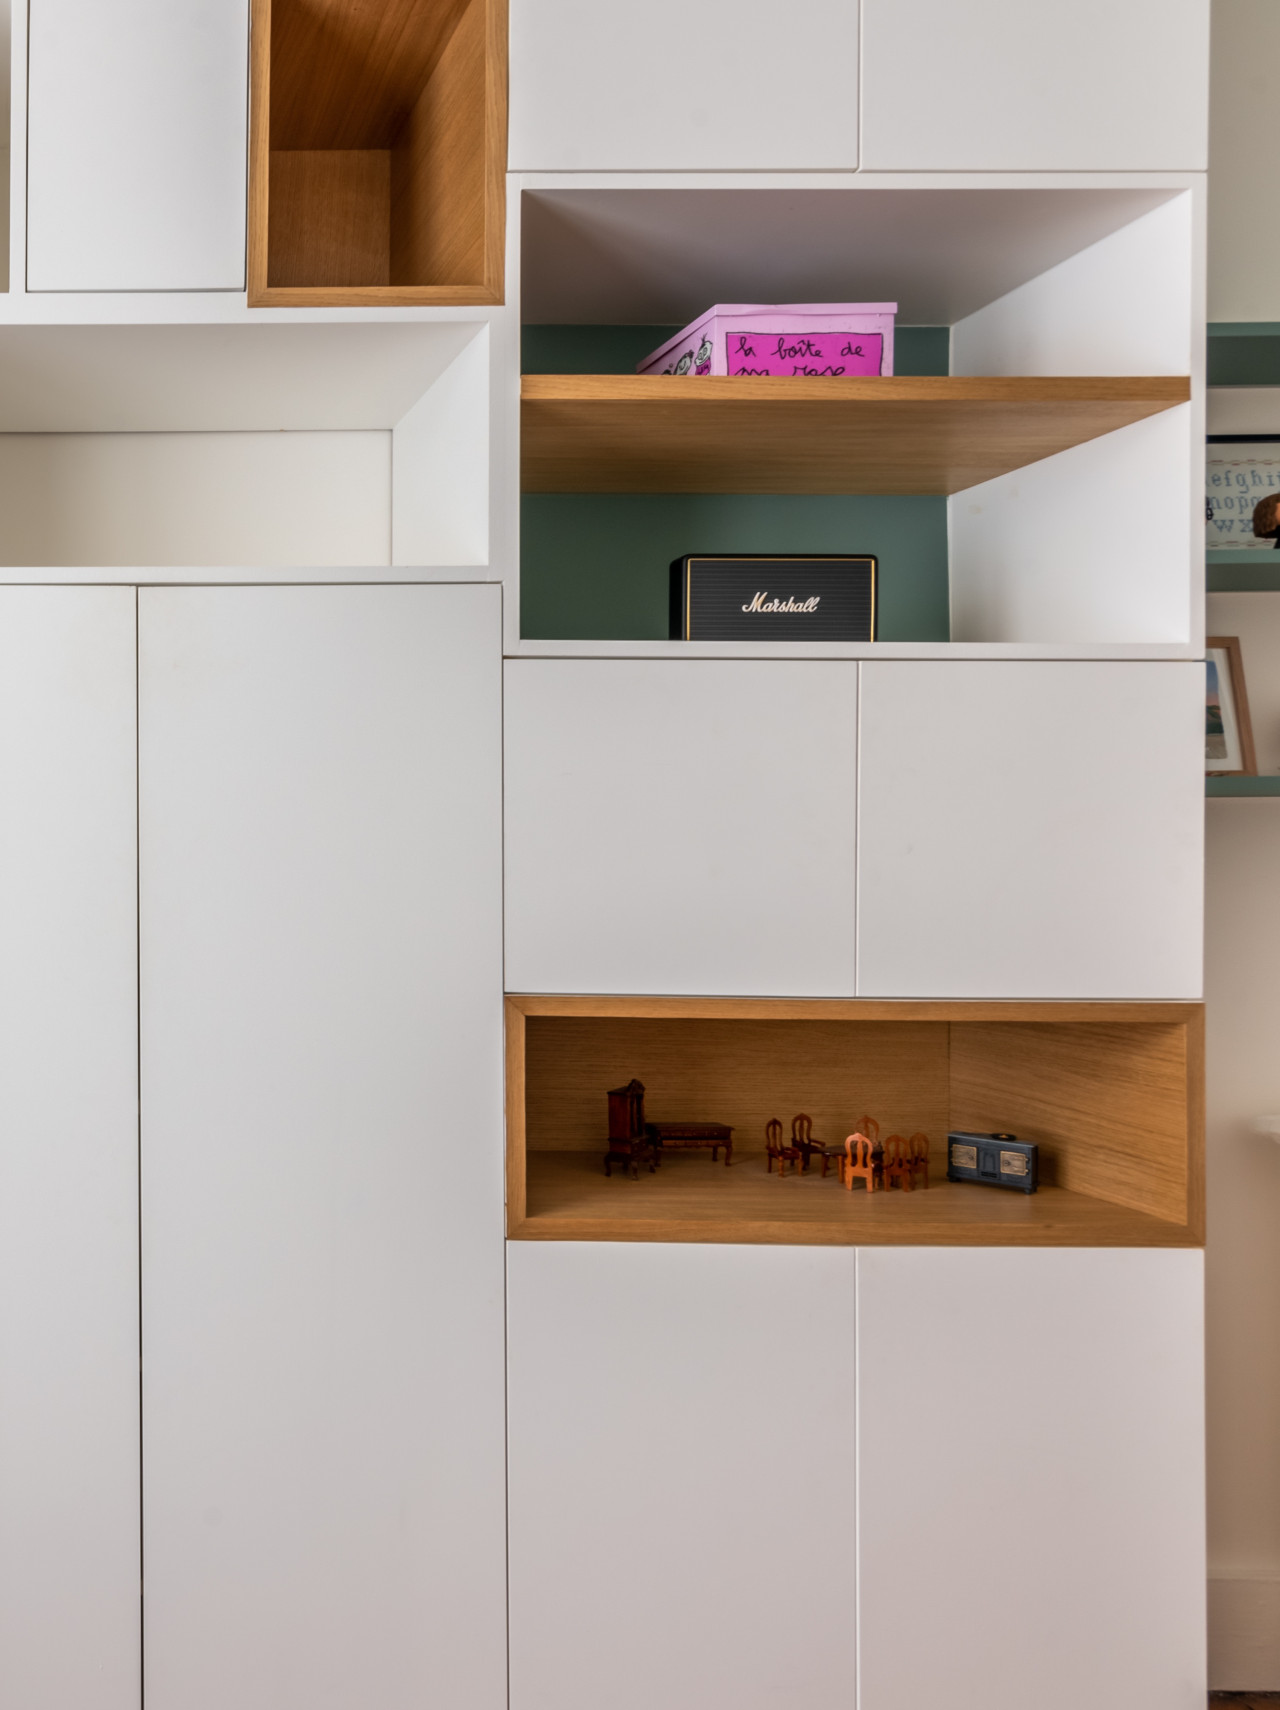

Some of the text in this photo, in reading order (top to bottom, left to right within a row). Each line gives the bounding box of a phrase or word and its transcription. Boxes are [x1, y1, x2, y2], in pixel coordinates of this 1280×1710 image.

[734, 336, 865, 360] la boîte de
[742, 592, 821, 612] Marshall
